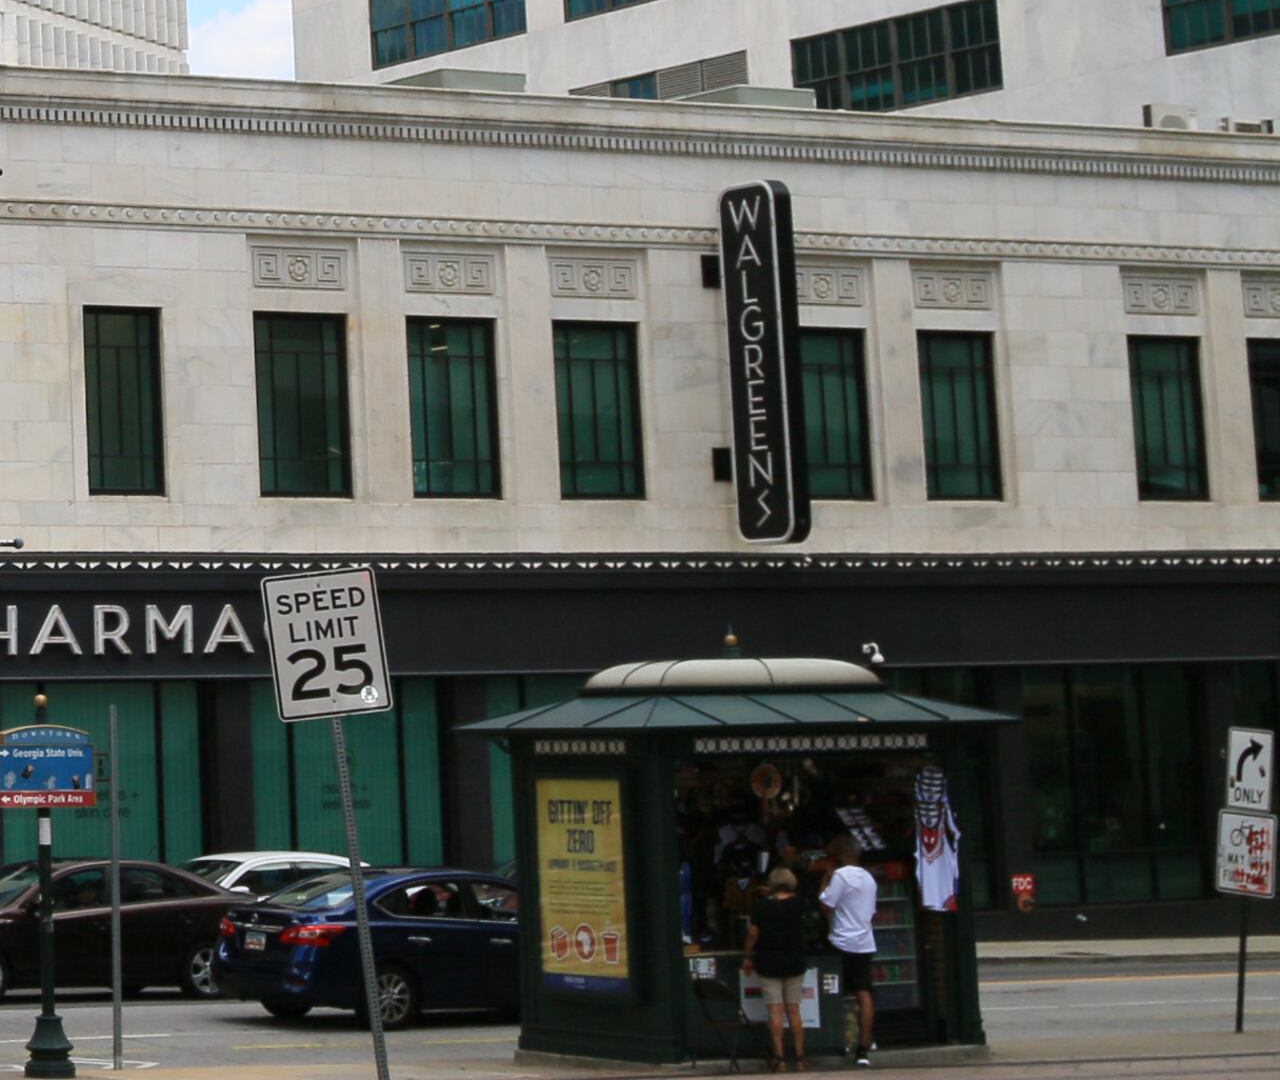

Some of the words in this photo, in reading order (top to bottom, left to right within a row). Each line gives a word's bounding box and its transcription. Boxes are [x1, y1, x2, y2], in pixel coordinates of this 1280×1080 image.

[727, 195, 774, 528] WALGREENS
[276, 586, 366, 616] SPEED
[288, 615, 359, 644] LIMIT
[286, 643, 374, 702] 25
[12, 748, 44, 760] Georgia
[45, 748, 66, 758] State
[13, 794, 46, 805] Olympic
[48, 794, 66, 803] Park
[67, 794, 84, 803] Area
[1233, 786, 1265, 804] ONLY
[1012, 877, 1033, 891] FDC
